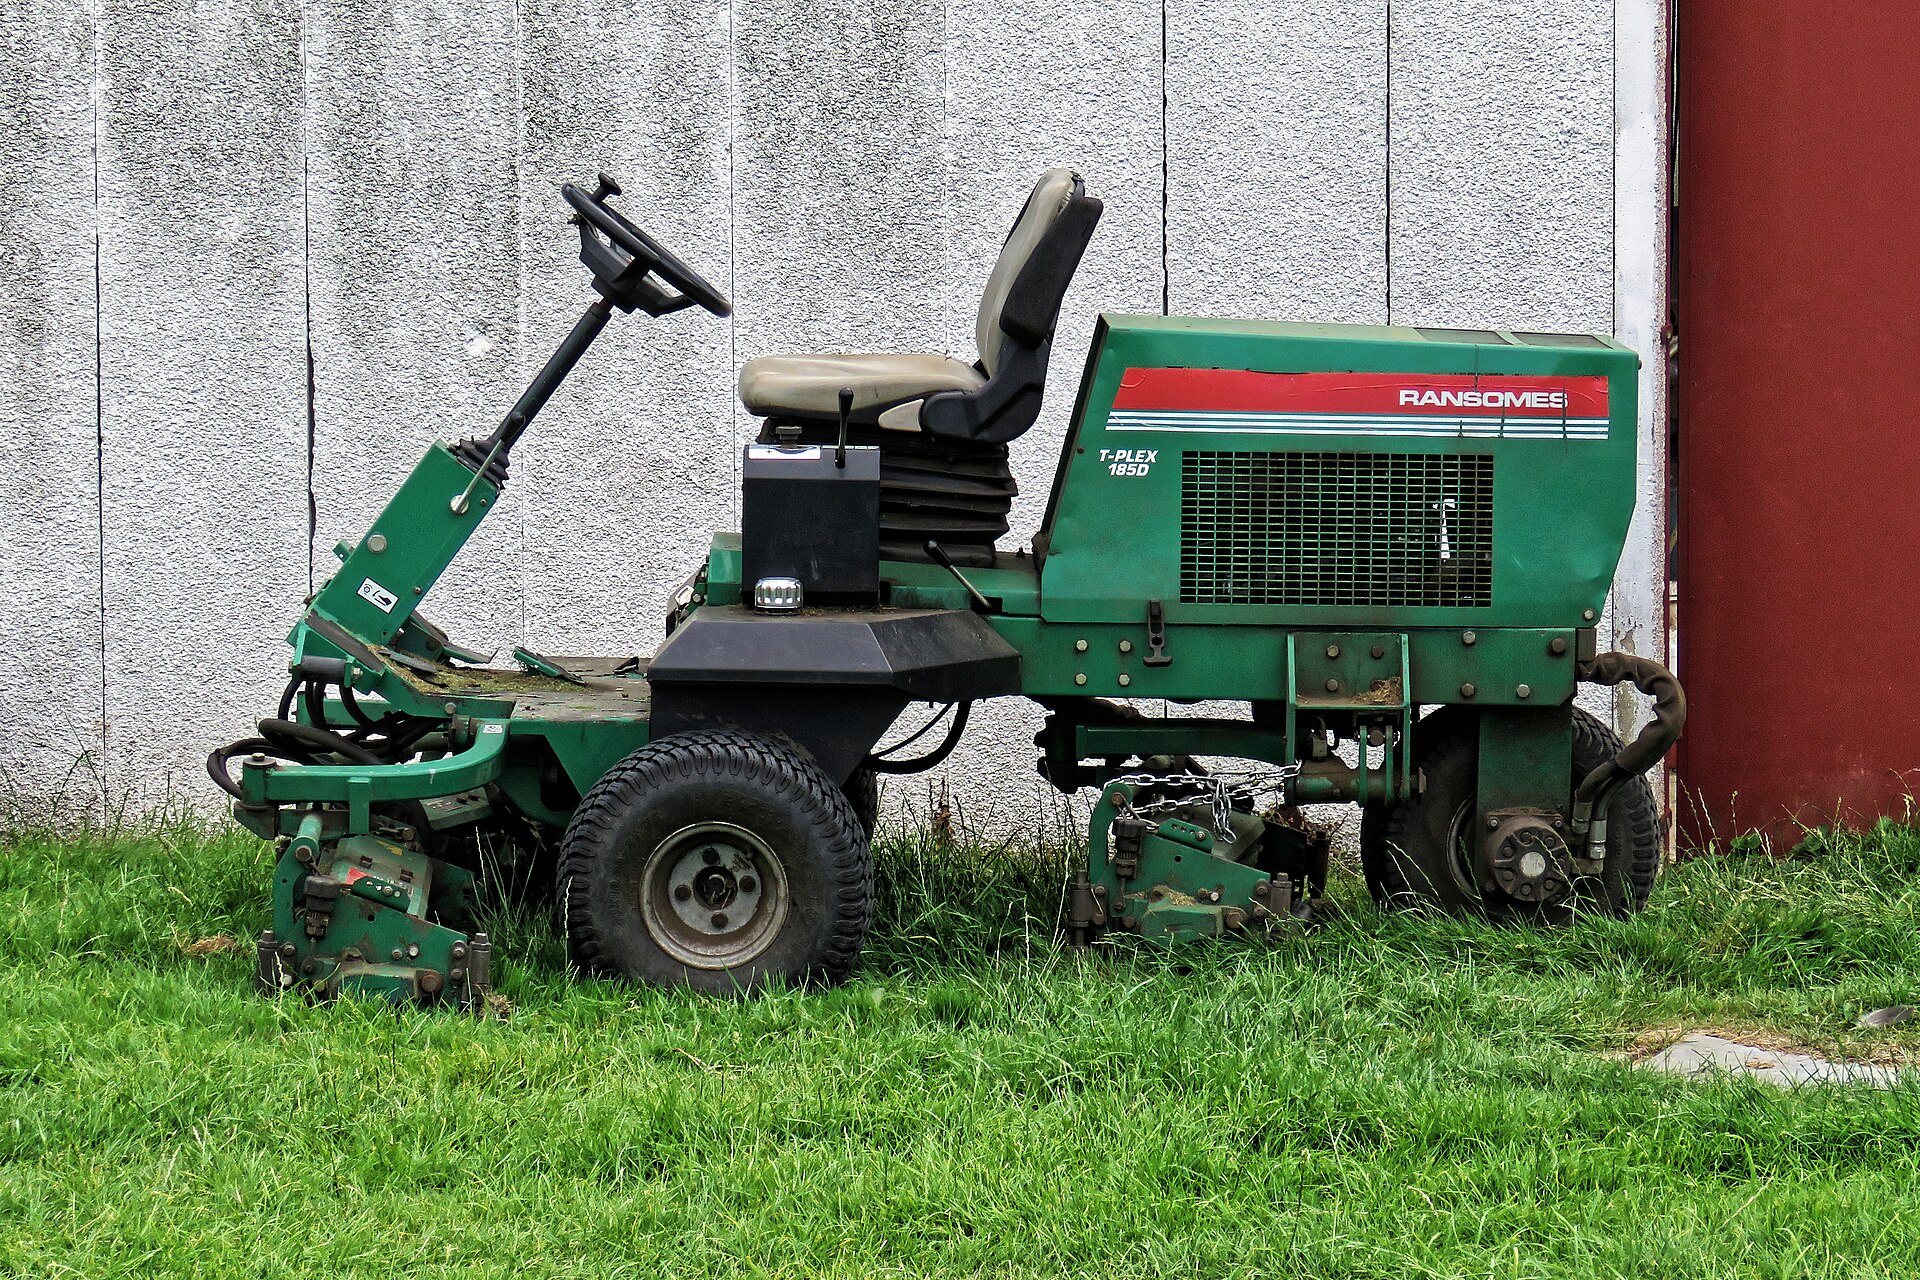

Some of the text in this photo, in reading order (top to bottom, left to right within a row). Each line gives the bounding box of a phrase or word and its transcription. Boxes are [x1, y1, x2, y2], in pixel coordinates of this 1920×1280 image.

[1399, 389, 1569, 408] RANSOMES
[1099, 449, 1159, 463] T-PLEX
[1108, 463, 1150, 476] 185D
